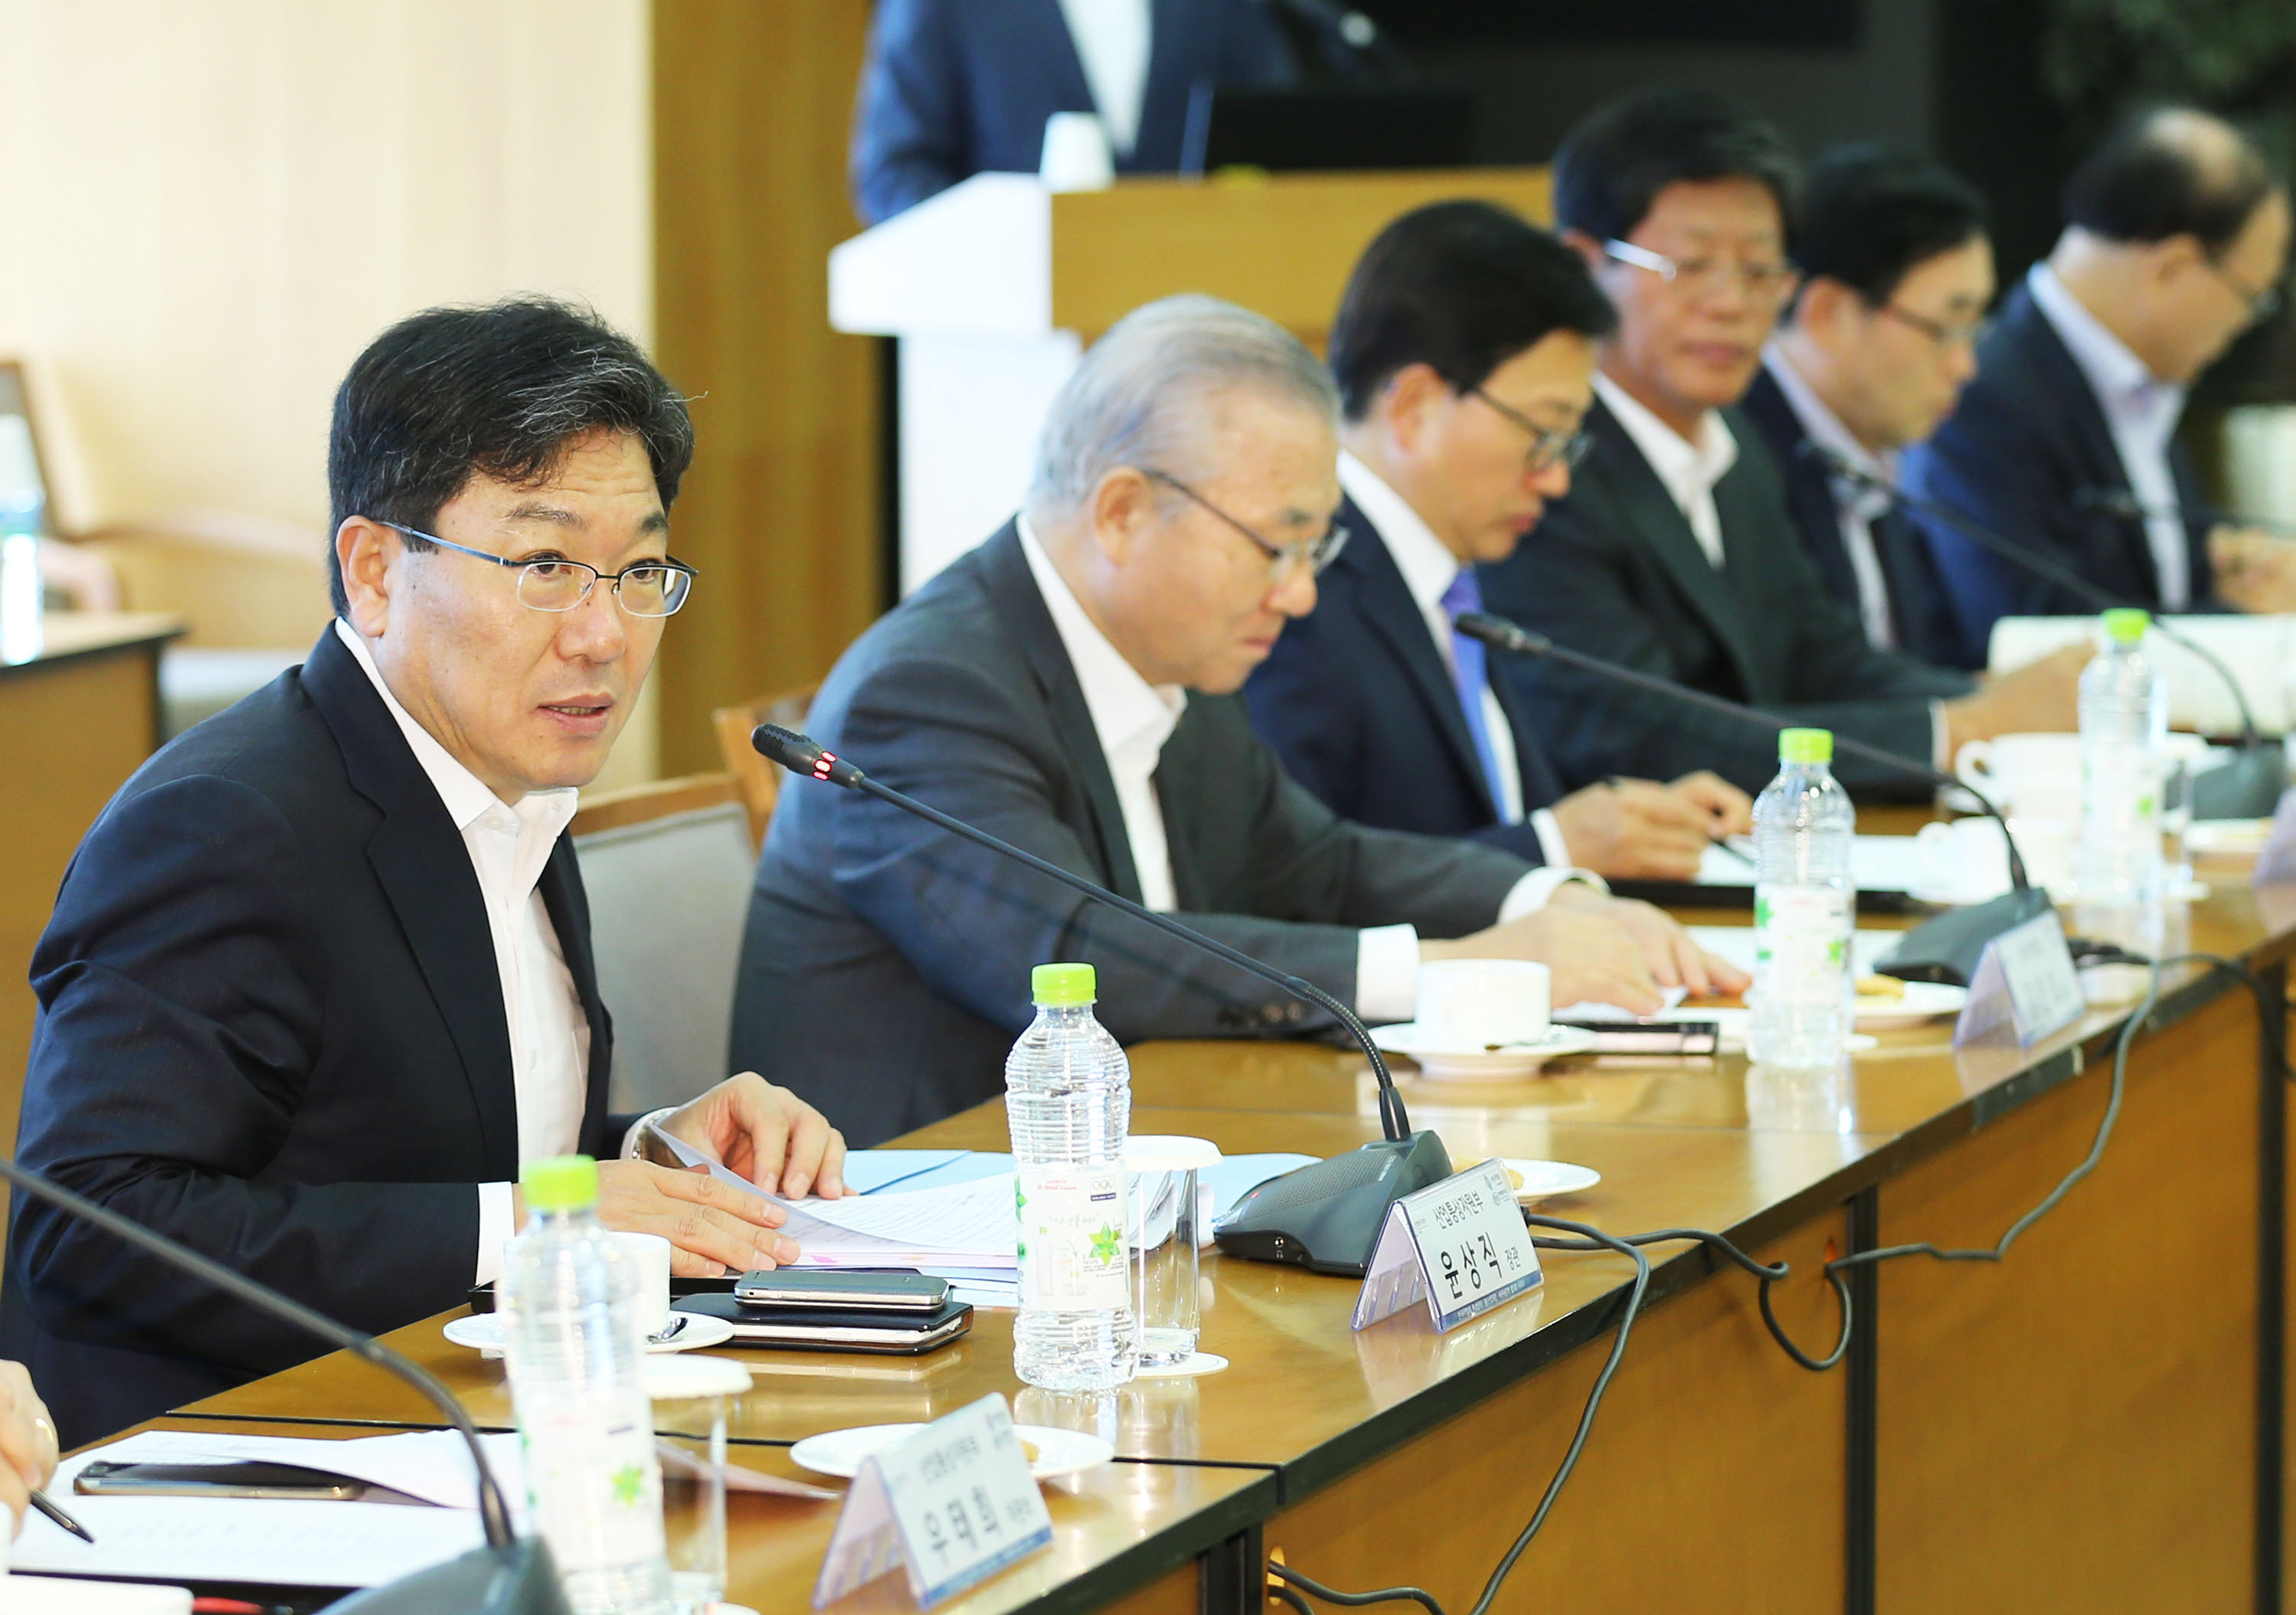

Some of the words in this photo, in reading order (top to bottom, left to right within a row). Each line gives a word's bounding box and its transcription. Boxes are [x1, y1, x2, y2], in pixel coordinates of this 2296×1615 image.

[1433, 1190, 1484, 1229] 산업통상자원부
[1441, 1231, 1503, 1299] 윤상직
[1505, 1246, 1520, 1270] 장관
